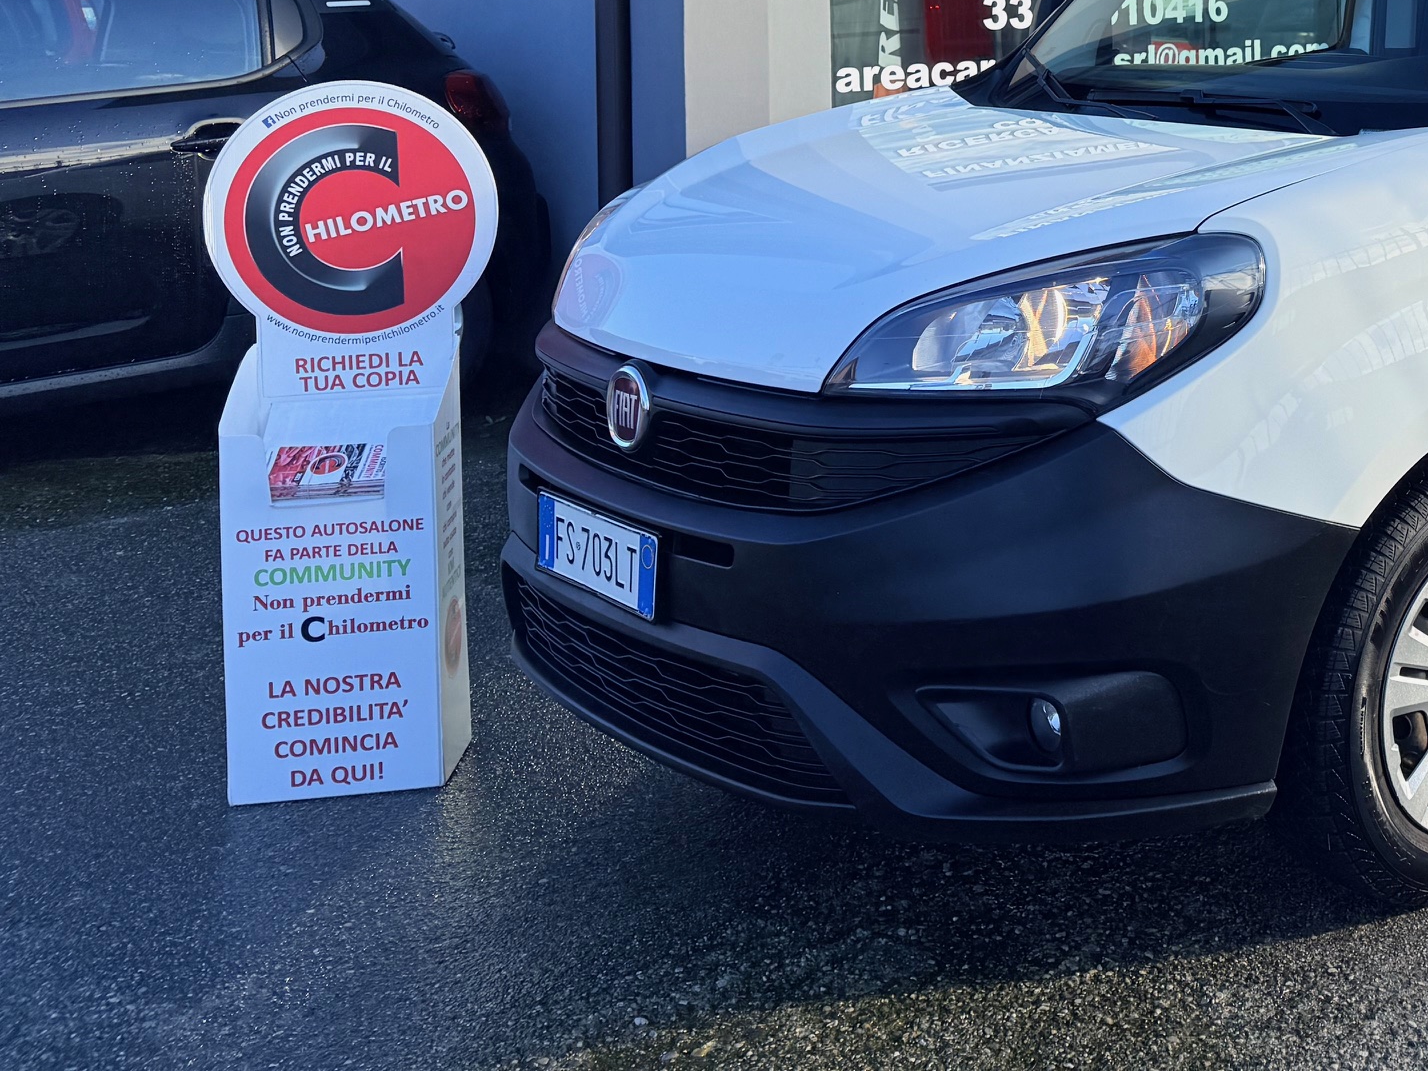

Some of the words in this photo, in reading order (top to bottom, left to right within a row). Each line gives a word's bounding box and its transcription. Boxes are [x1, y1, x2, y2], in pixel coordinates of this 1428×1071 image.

[274, 105, 297, 122] Non
[298, 93, 355, 113] prendermi
[357, 94, 376, 104] per
[378, 94, 385, 104] il
[386, 98, 440, 130] Chilometro
[345, 151, 376, 167] PER
[378, 155, 393, 172] IL
[278, 154, 342, 222] PRENDERMI
[279, 225, 303, 258] NON
[266, 303, 445, 346] www.nonprendermiperilchilometro.it
[295, 353, 391, 375] RICHIEDI
[396, 350, 424, 368] LA
[299, 374, 348, 393] TUA
[351, 370, 421, 389] COPIA
[613, 389, 638, 429] FIAT
[235, 525, 306, 544] QUESTO
[310, 517, 425, 538] AUTOSALONE
[264, 546, 285, 563] FA
[290, 544, 342, 560] PARTE
[347, 541, 399, 558] DELLA
[253, 558, 412, 588] COMMUNITY
[253, 593, 296, 612] Non
[301, 585, 412, 613] prendermi
[237, 627, 274, 648] per
[279, 623, 294, 641] il
[300, 614, 429, 643] Chilometro
[268, 680, 297, 699] LA
[304, 671, 402, 696] NOSTRA
[261, 701, 409, 730] CREDIBILITA'
[274, 731, 399, 759] COMINCIA
[290, 767, 324, 788] DA
[331, 762, 384, 787] QUI!
